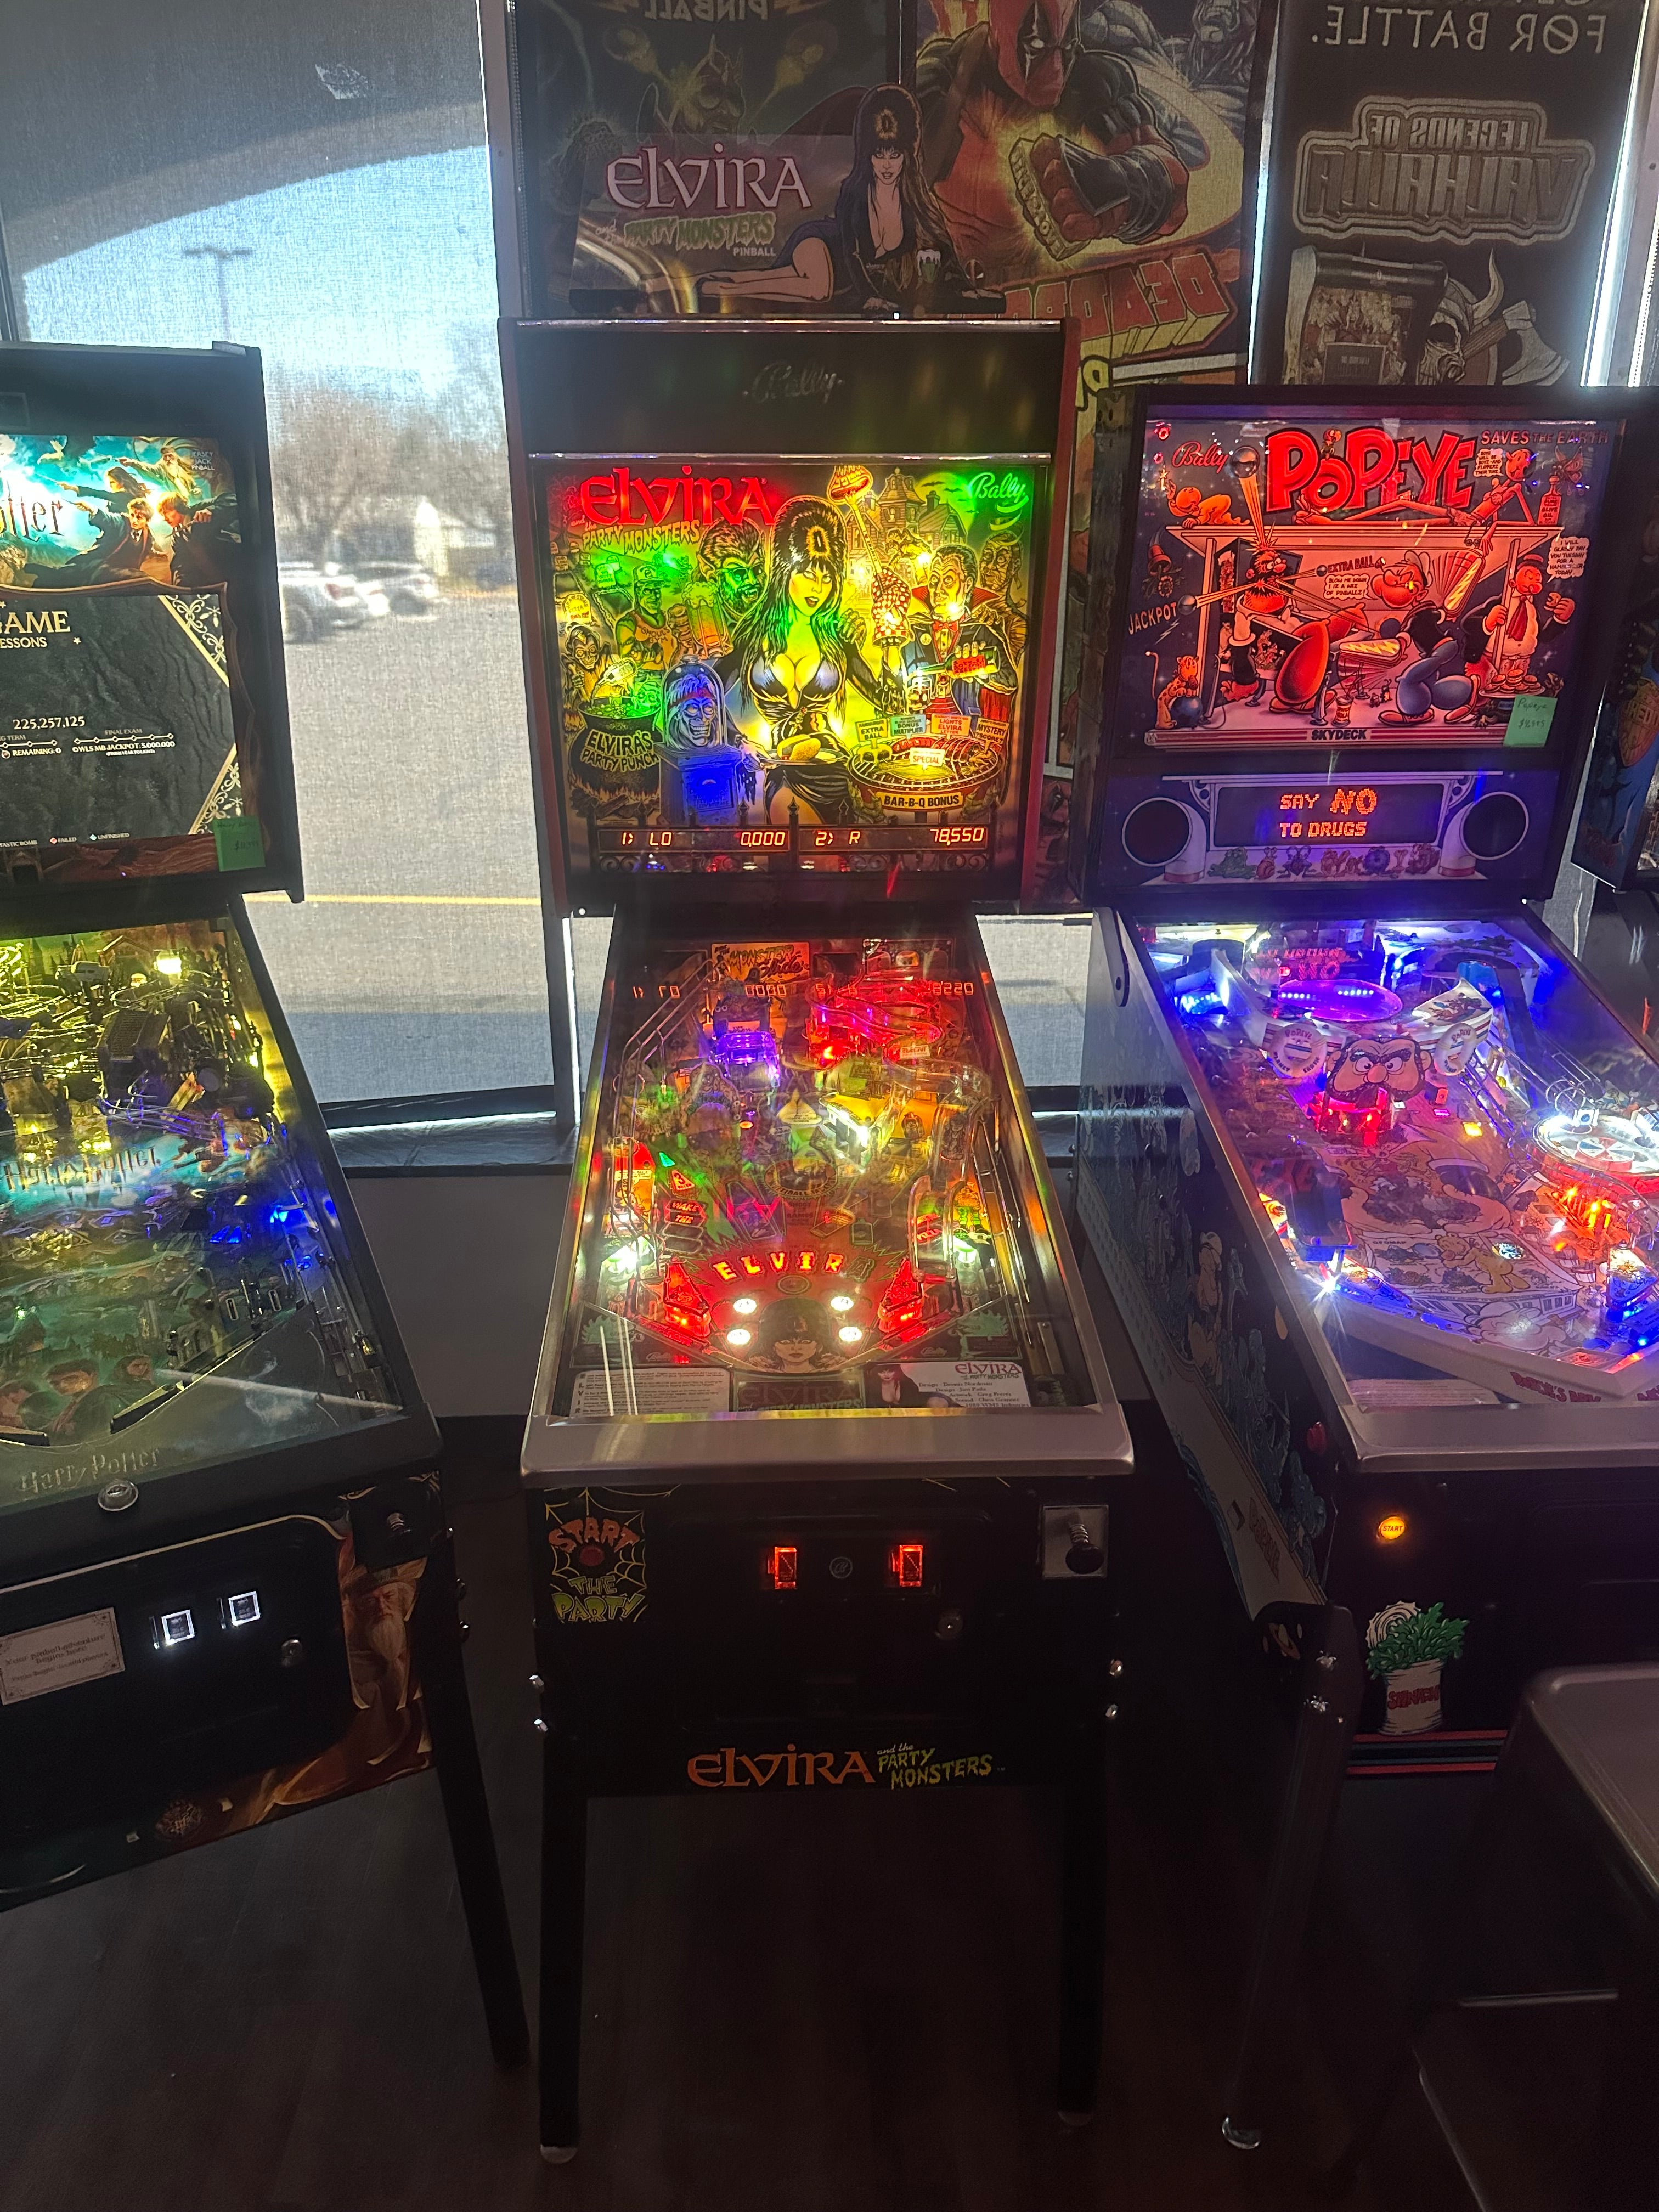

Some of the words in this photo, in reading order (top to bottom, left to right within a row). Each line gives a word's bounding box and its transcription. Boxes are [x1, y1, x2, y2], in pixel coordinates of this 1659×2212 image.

[733, 247, 776, 257] PINBALL
[1481, 430, 1530, 445] SAVES
[1532, 433, 1554, 443] THE
[1556, 428, 1610, 444] EARTH
[1172, 441, 1229, 473] Bally
[1265, 426, 1479, 516] POPEYE
[968, 472, 1026, 500] Bally
[582, 525, 624, 550] PARTY
[623, 520, 701, 554] MONSTERS
[1327, 560, 1354, 573] EXTRA
[1355, 555, 1375, 570] BALL
[0, 611, 71, 634] AME
[1128, 602, 1177, 635] JACKPOT
[0, 636, 48, 648] ESSONS
[861, 726, 884, 735] EXTRA
[864, 732, 883, 741] BALL
[977, 724, 1007, 736] MYSTERY
[1311, 729, 1368, 741] SKYDECK
[586, 730, 653, 757] ELVIRA'S
[582, 749, 619, 771] PARTY
[620, 752, 660, 771] PUNCH
[912, 755, 940, 764] SPECIAL
[884, 795, 925, 808] BAR-B-Q
[927, 795, 960, 806] BONUS
[1280, 794, 1319, 809] SAY
[1329, 788, 1378, 815] NO
[97, 832, 130, 840] UNFINISHED
[649, 831, 673, 845] LO
[1279, 822, 1302, 838] TO
[1308, 821, 1368, 838] DRUGS
[729, 944, 795, 968] MONSTER
[1285, 1028, 1313, 1040] POPEYE
[672, 1202, 699, 1212] WAKE
[675, 1215, 693, 1224] THE
[549, 1517, 640, 1553] START
[1383, 1524, 1403, 1533] START
[568, 1576, 617, 1595] THE
[552, 1592, 646, 1622] PARTY
[877, 1746, 896, 1755] and
[898, 1742, 915, 1752] the
[878, 1747, 935, 1773] PARTY
[891, 1754, 994, 1790] MONSTERS
